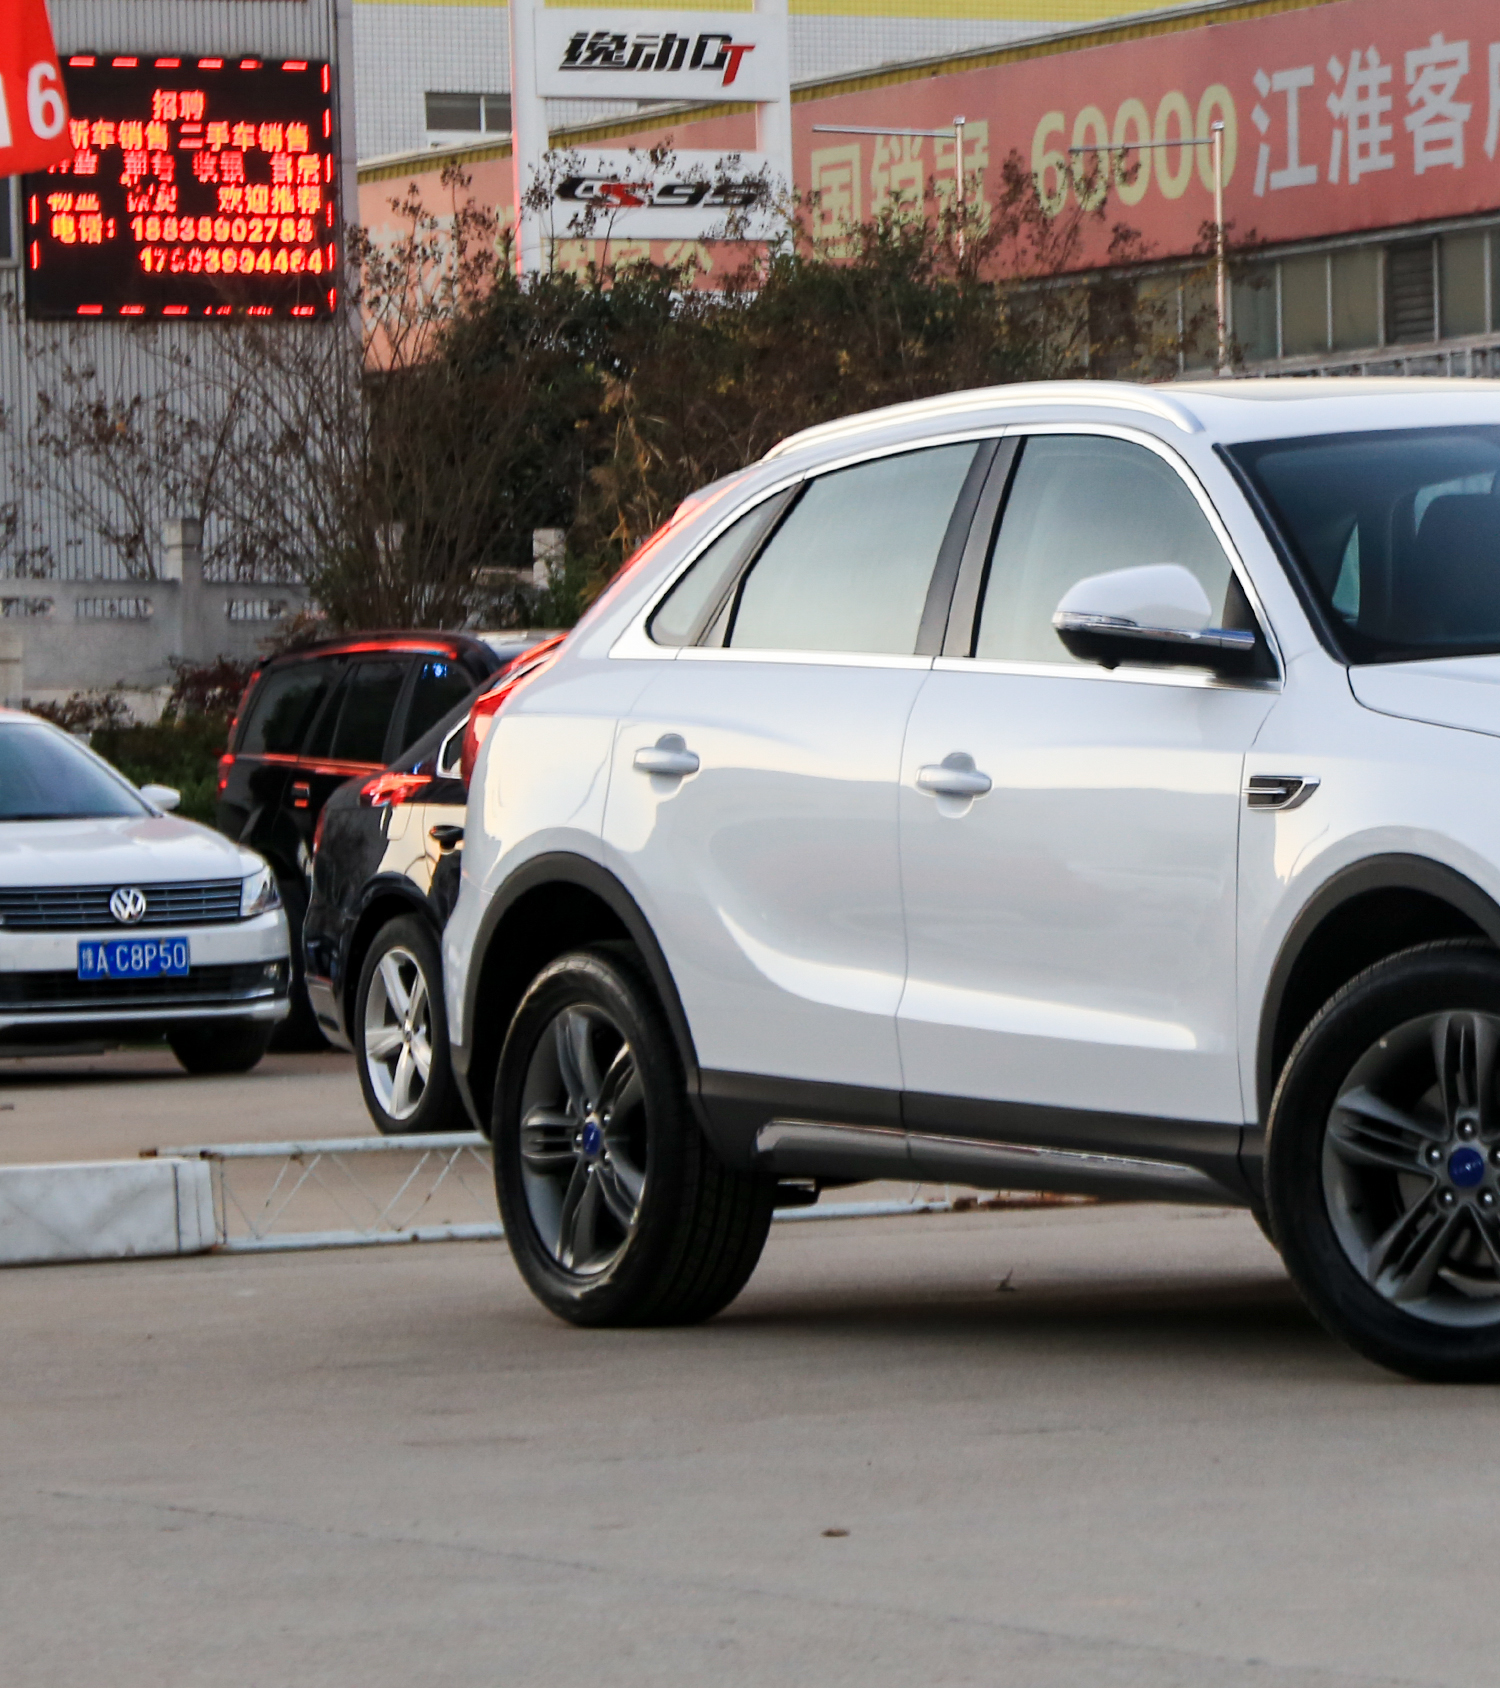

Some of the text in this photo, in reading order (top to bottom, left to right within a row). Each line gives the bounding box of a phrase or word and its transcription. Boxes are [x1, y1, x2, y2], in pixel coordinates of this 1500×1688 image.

[152, 89, 205, 121] 招聘
[178, 121, 309, 153] 二手车销售
[217, 183, 321, 214] 欢迎推荐
